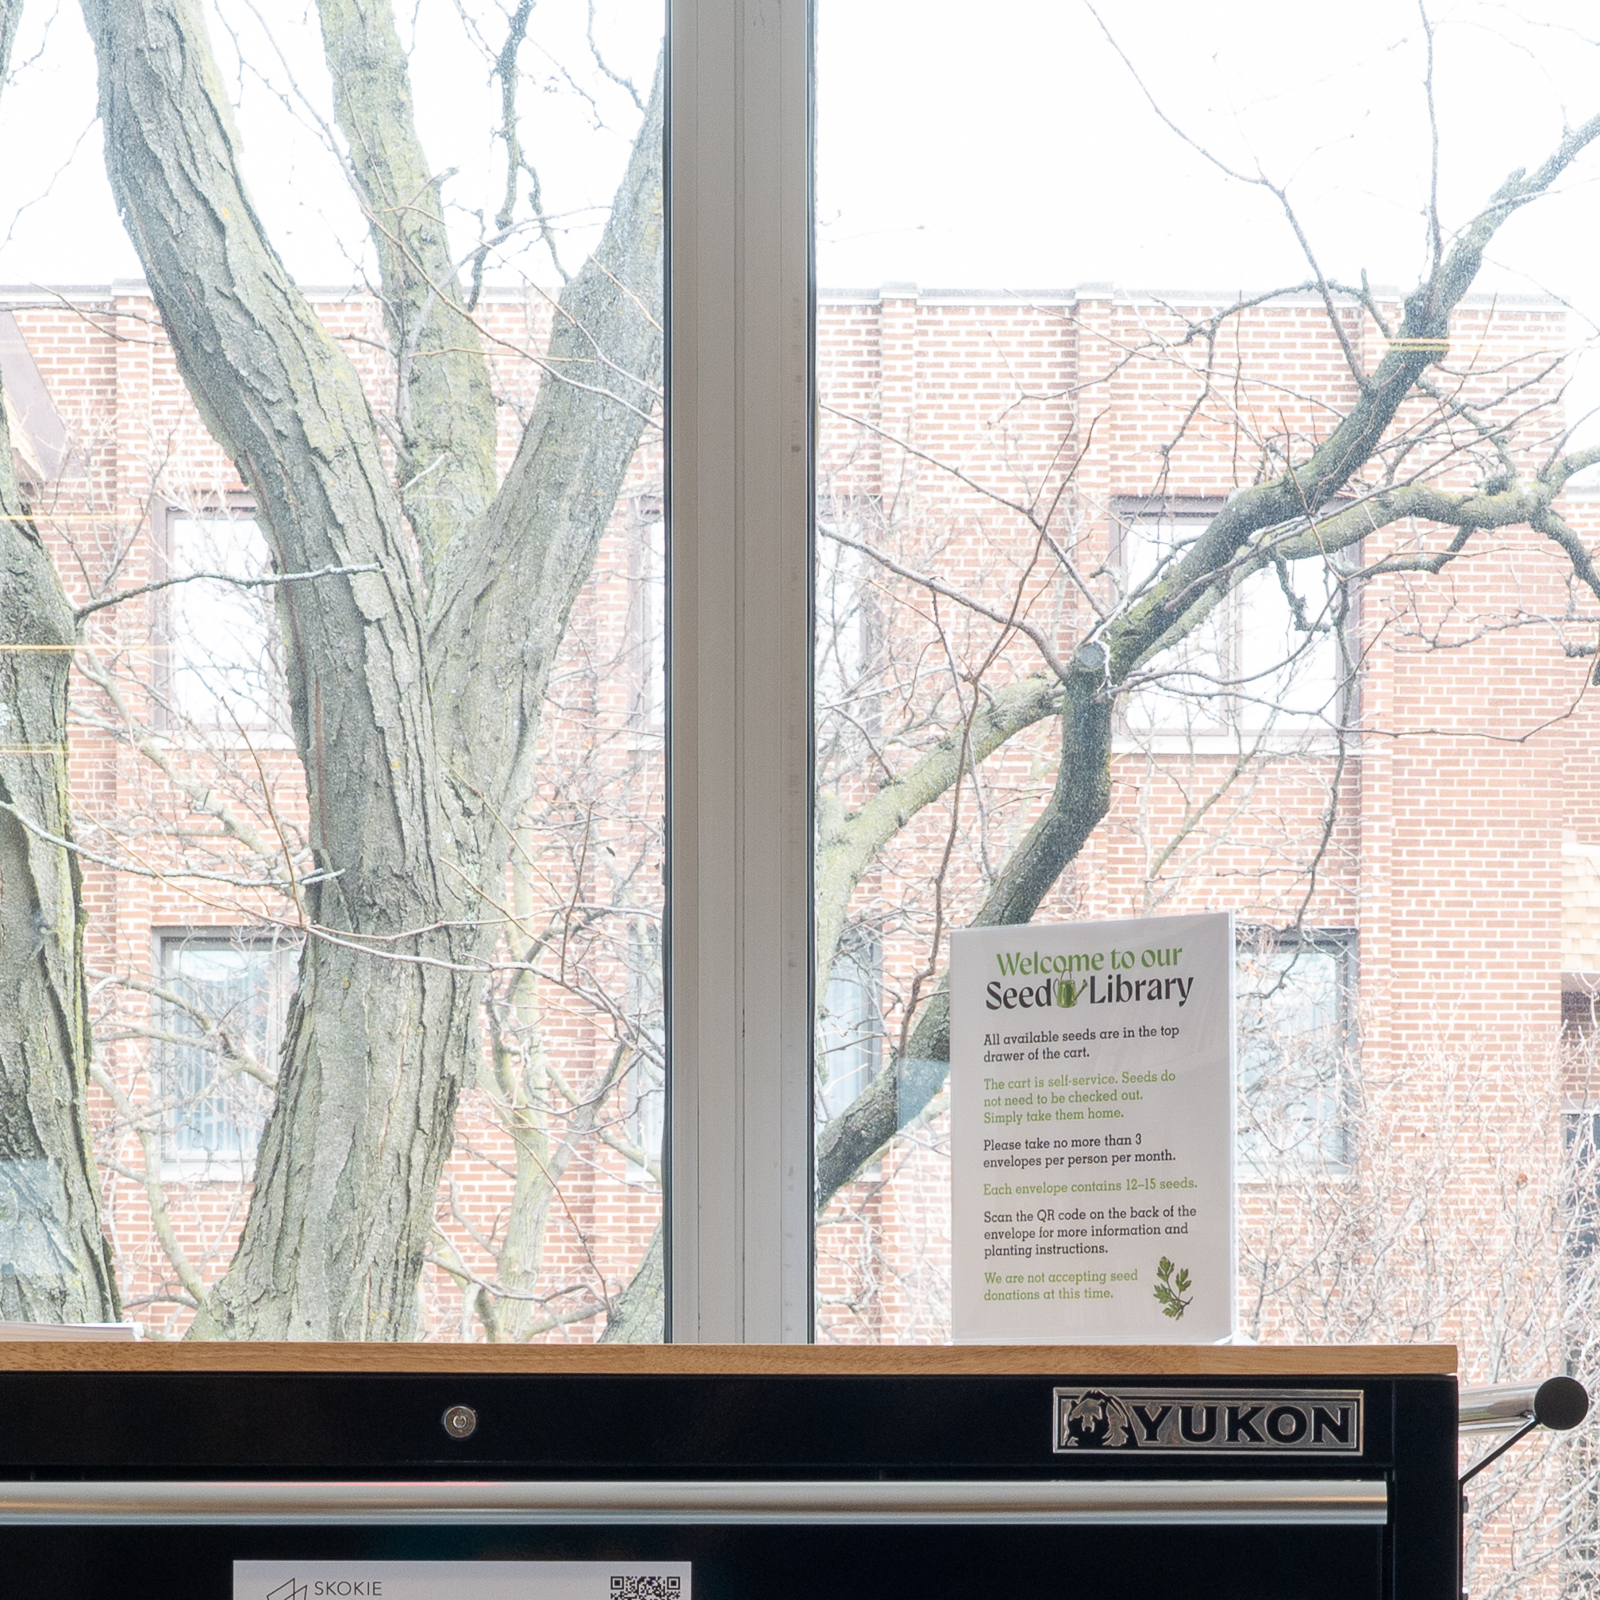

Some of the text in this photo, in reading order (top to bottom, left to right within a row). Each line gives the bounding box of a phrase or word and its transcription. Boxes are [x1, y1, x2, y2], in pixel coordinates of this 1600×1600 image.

[996, 947, 1183, 976] Welcome to our
[985, 974, 1194, 1010] Seed Library
[984, 1025, 1180, 1046] All available seeds are in the top
[984, 1047, 1090, 1063] drawer of the cart.
[984, 1070, 1176, 1090] The cart is self-service. Seeds do
[984, 1090, 1142, 1107] not need to be checked out.
[984, 1108, 1124, 1126] Simply take them home.
[984, 1133, 1142, 1151] Please take no more than 3
[983, 1150, 1176, 1169] envelopes per person per month.
[983, 1183, 1012, 1196] Each
[1015, 1181, 1068, 1196] envelope
[1071, 1180, 1122, 1193] contains
[1159, 1177, 1198, 1189] seeds.
[984, 1205, 1197, 1223] Scan the QR code on the back of the
[984, 1223, 1188, 1240] envelope for more information and
[984, 1243, 1108, 1259] planting instructions.
[985, 1270, 1138, 1285] We are not accepting seed
[984, 1287, 1113, 1301] donations at this time.
[1131, 1405, 1351, 1444] YUKON
[314, 1581, 382, 1596] SKOKIE
